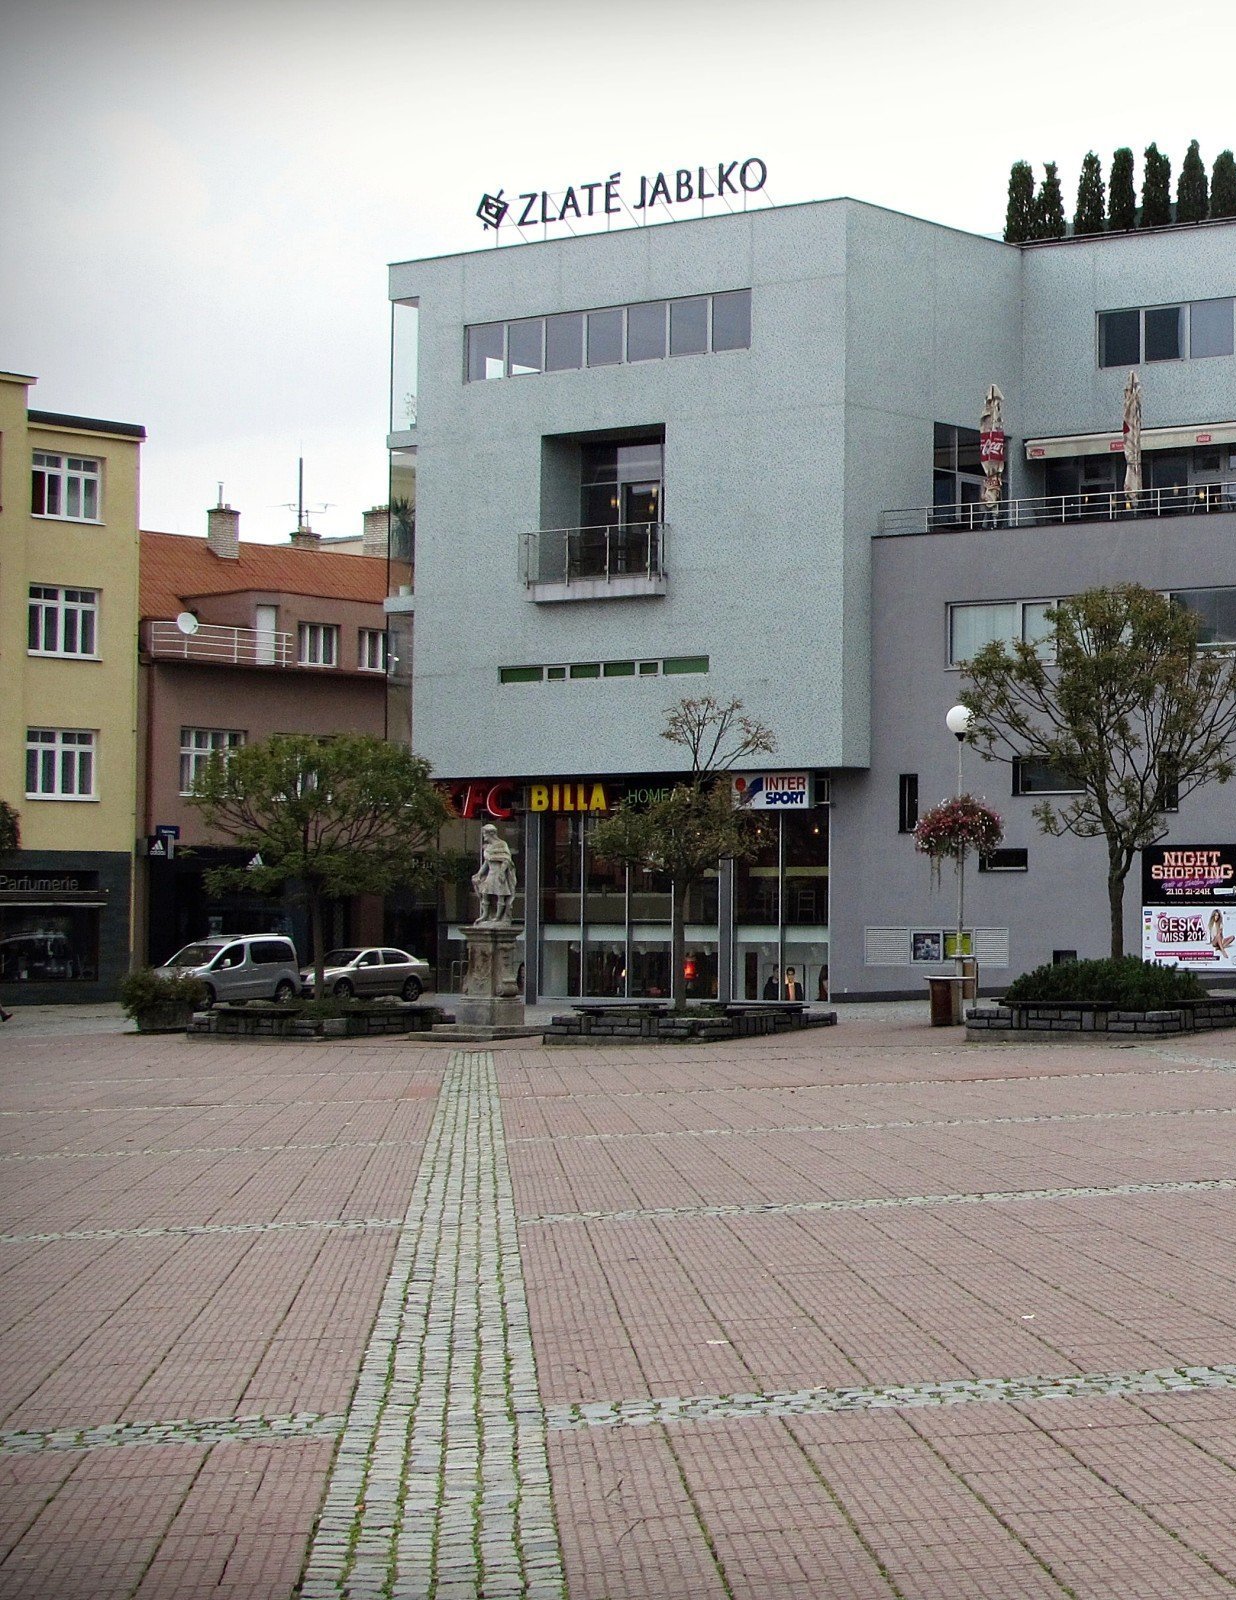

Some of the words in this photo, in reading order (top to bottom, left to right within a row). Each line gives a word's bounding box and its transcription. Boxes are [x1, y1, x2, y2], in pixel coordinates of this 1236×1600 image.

[517, 172, 621, 226] ZLATÉ
[633, 157, 767, 210] JABLKO
[765, 776, 806, 791] INTER
[451, 781, 515, 820] FC
[530, 782, 607, 812] BILLA
[765, 790, 806, 805] SPORT
[1162, 851, 1221, 867] NIGHT
[1151, 864, 1234, 880] SHOPPING
[1161, 932, 1185, 943] MISS
[1187, 931, 1207, 942] 2012
